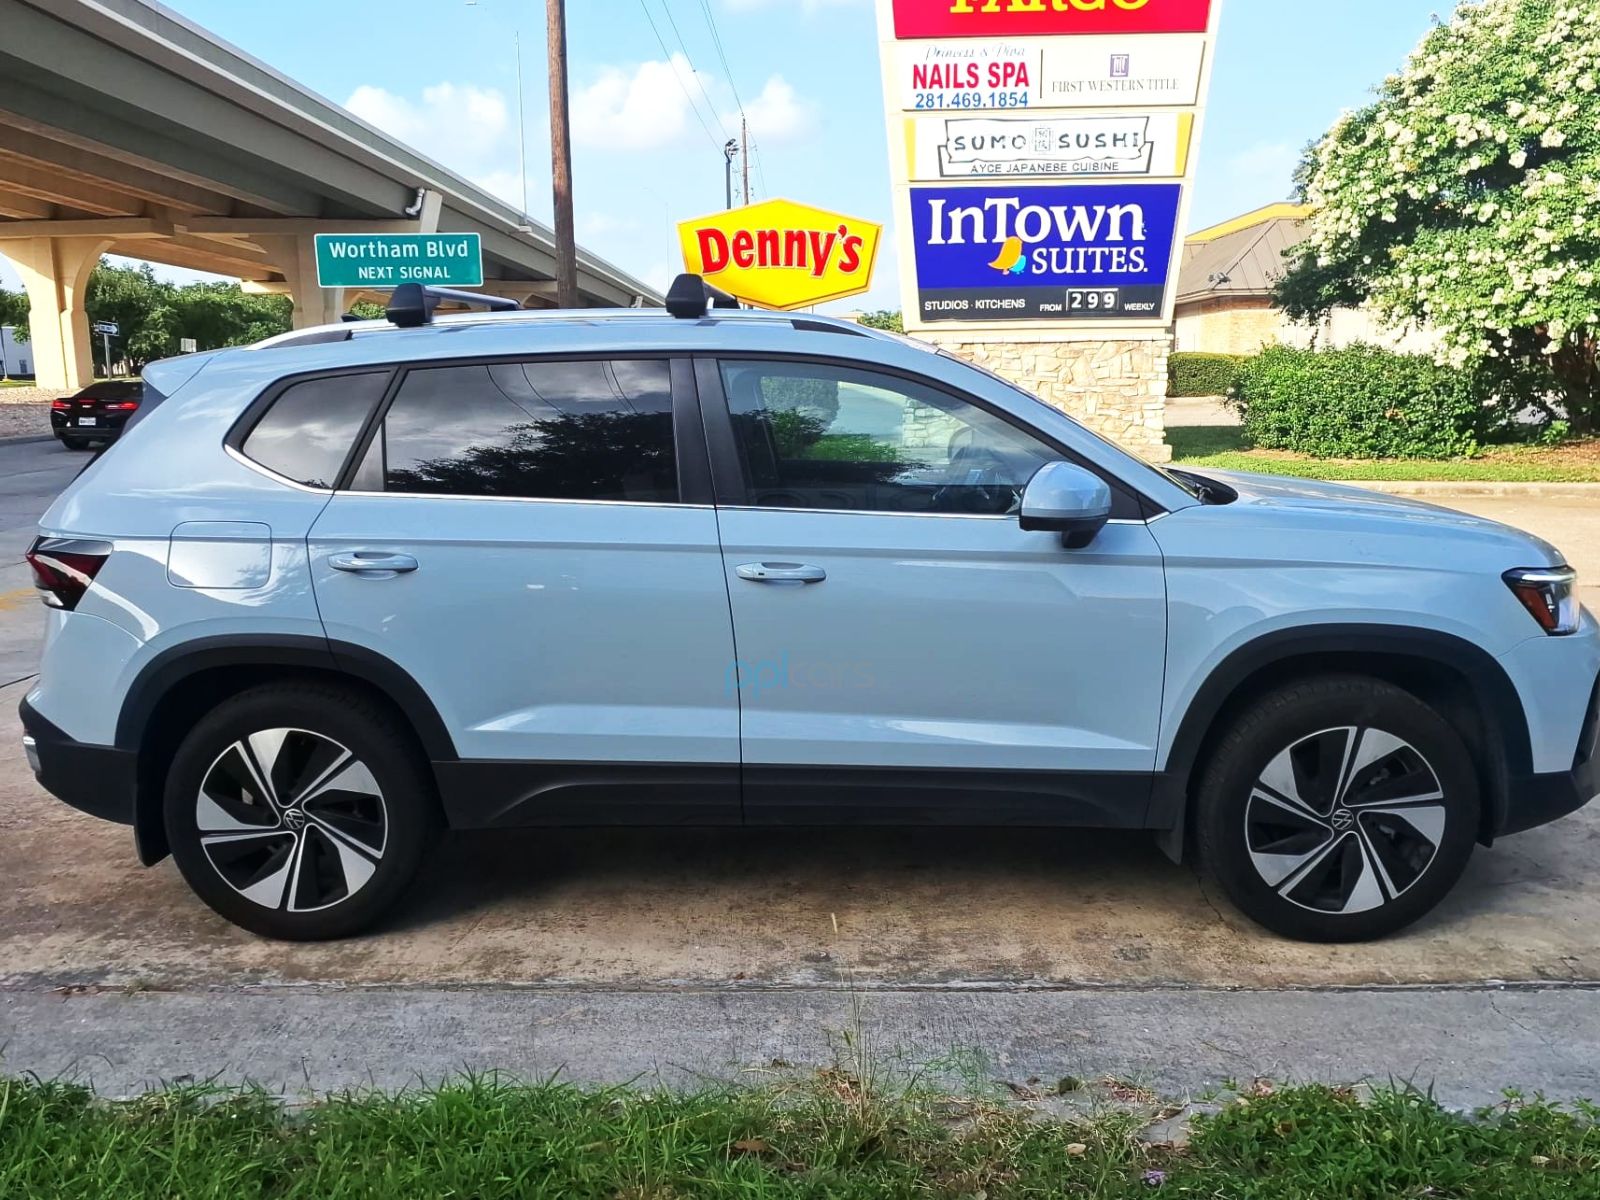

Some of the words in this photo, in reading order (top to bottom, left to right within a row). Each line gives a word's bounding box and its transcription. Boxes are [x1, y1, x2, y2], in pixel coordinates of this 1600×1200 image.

[913, 63, 979, 90] NAILS
[987, 62, 1030, 88] SPA
[1052, 80, 1084, 93] FIRST
[1087, 79, 1144, 92] WESTERN
[1147, 78, 1180, 91] TITLE
[915, 92, 1029, 109] 281.469.1854
[954, 135, 1026, 151] SUMO
[1058, 132, 1140, 149] SUSHI
[970, 164, 1002, 174] AYCE
[1006, 162, 1068, 173] JAPANESE
[927, 197, 1146, 245] InTown
[329, 241, 419, 258] Wortham
[426, 240, 469, 258] Blvd
[695, 224, 863, 276] Denny's
[358, 267, 394, 280] NEXT
[400, 266, 451, 279] SIGNAL
[924, 300, 969, 311] STUDIOS
[974, 298, 1026, 310] KITCHENS
[1039, 303, 1063, 312] FROM
[1070, 292, 1116, 310] 299
[1124, 301, 1155, 312] WEEKLY
